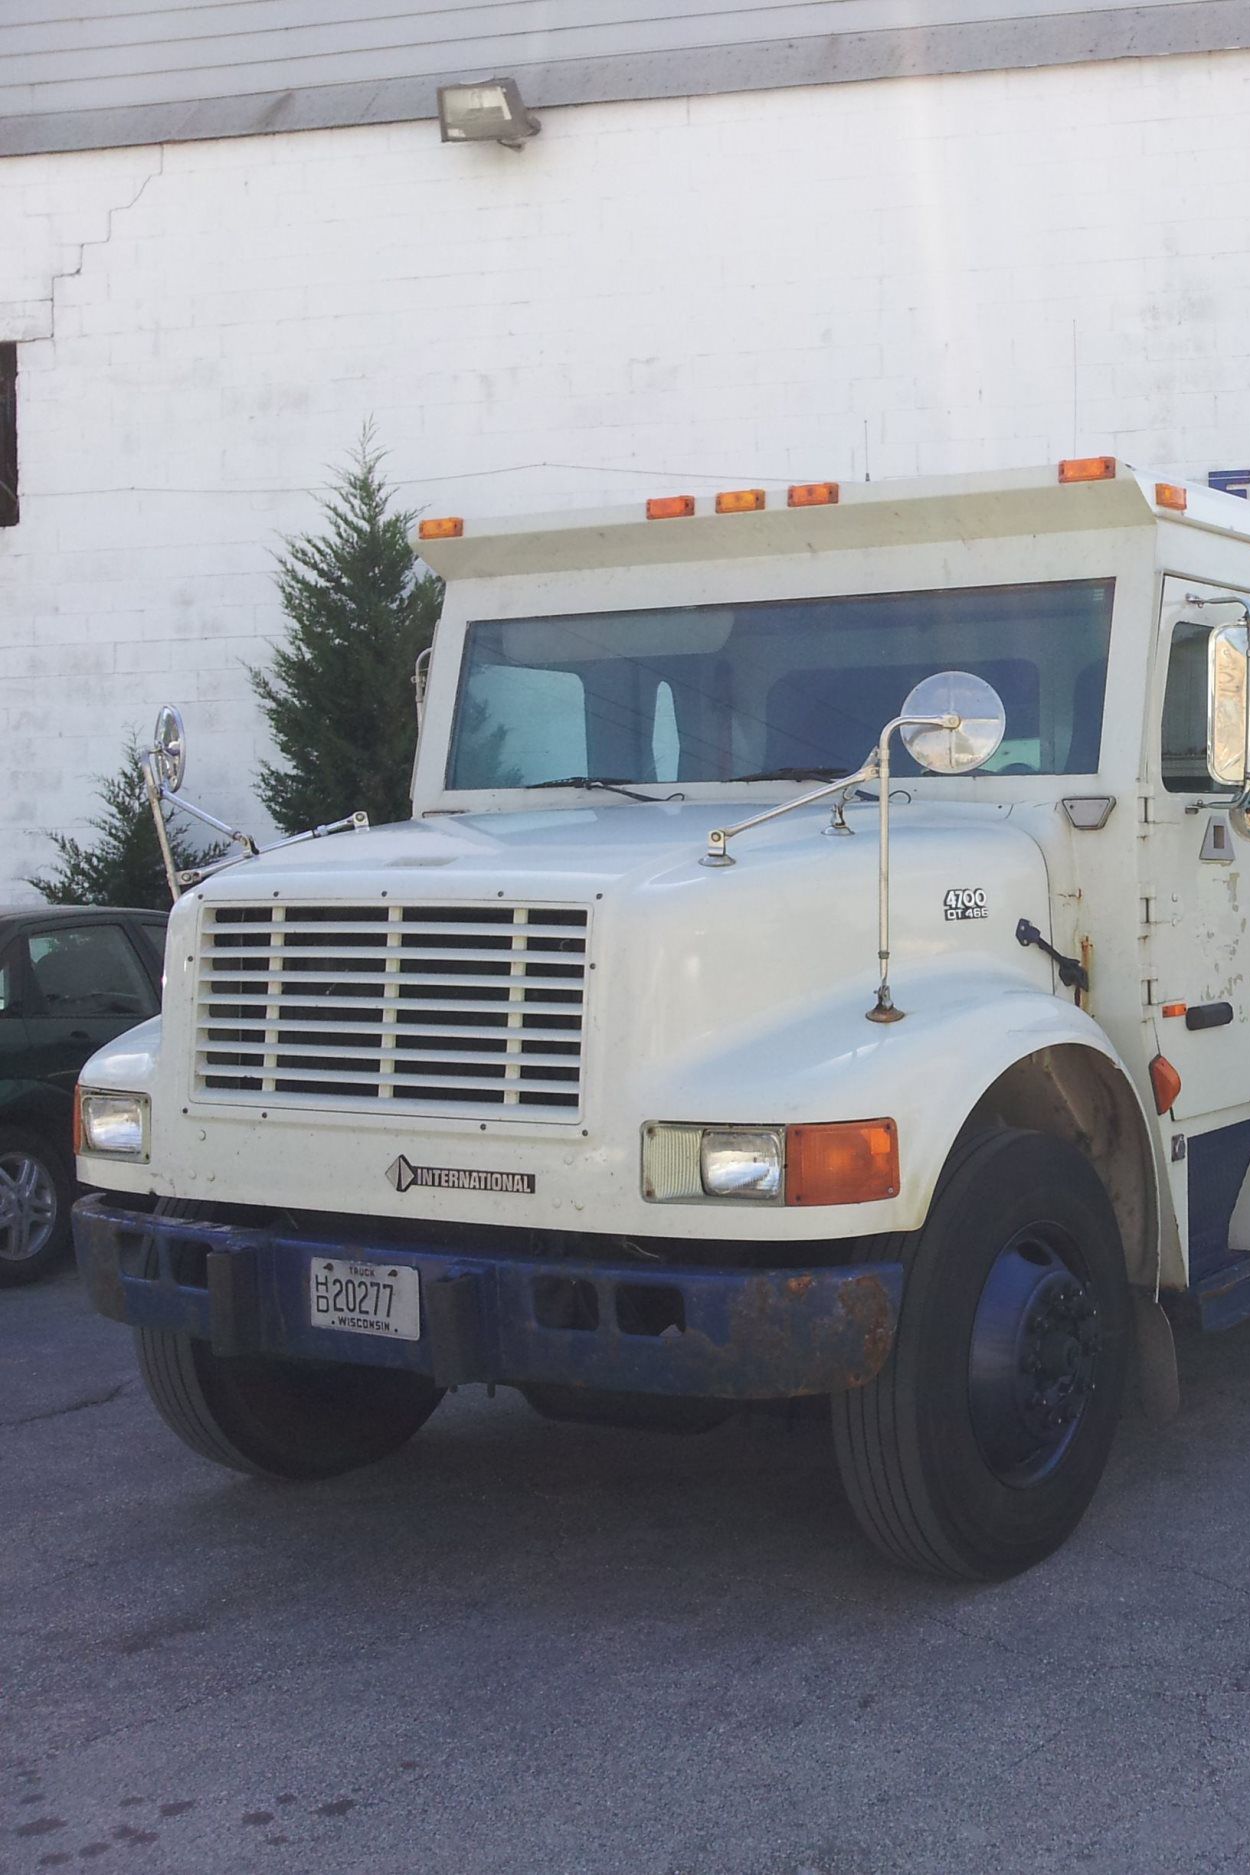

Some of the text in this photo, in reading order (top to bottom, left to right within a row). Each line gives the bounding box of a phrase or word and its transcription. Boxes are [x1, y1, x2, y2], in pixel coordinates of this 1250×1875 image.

[945, 888, 987, 908] 4700
[416, 1168, 531, 1193] INTERNATIONAL
[348, 1266, 375, 1277] TRUCK
[332, 1278, 394, 1318] 20277
[338, 1316, 390, 1332] WISCONSIN
